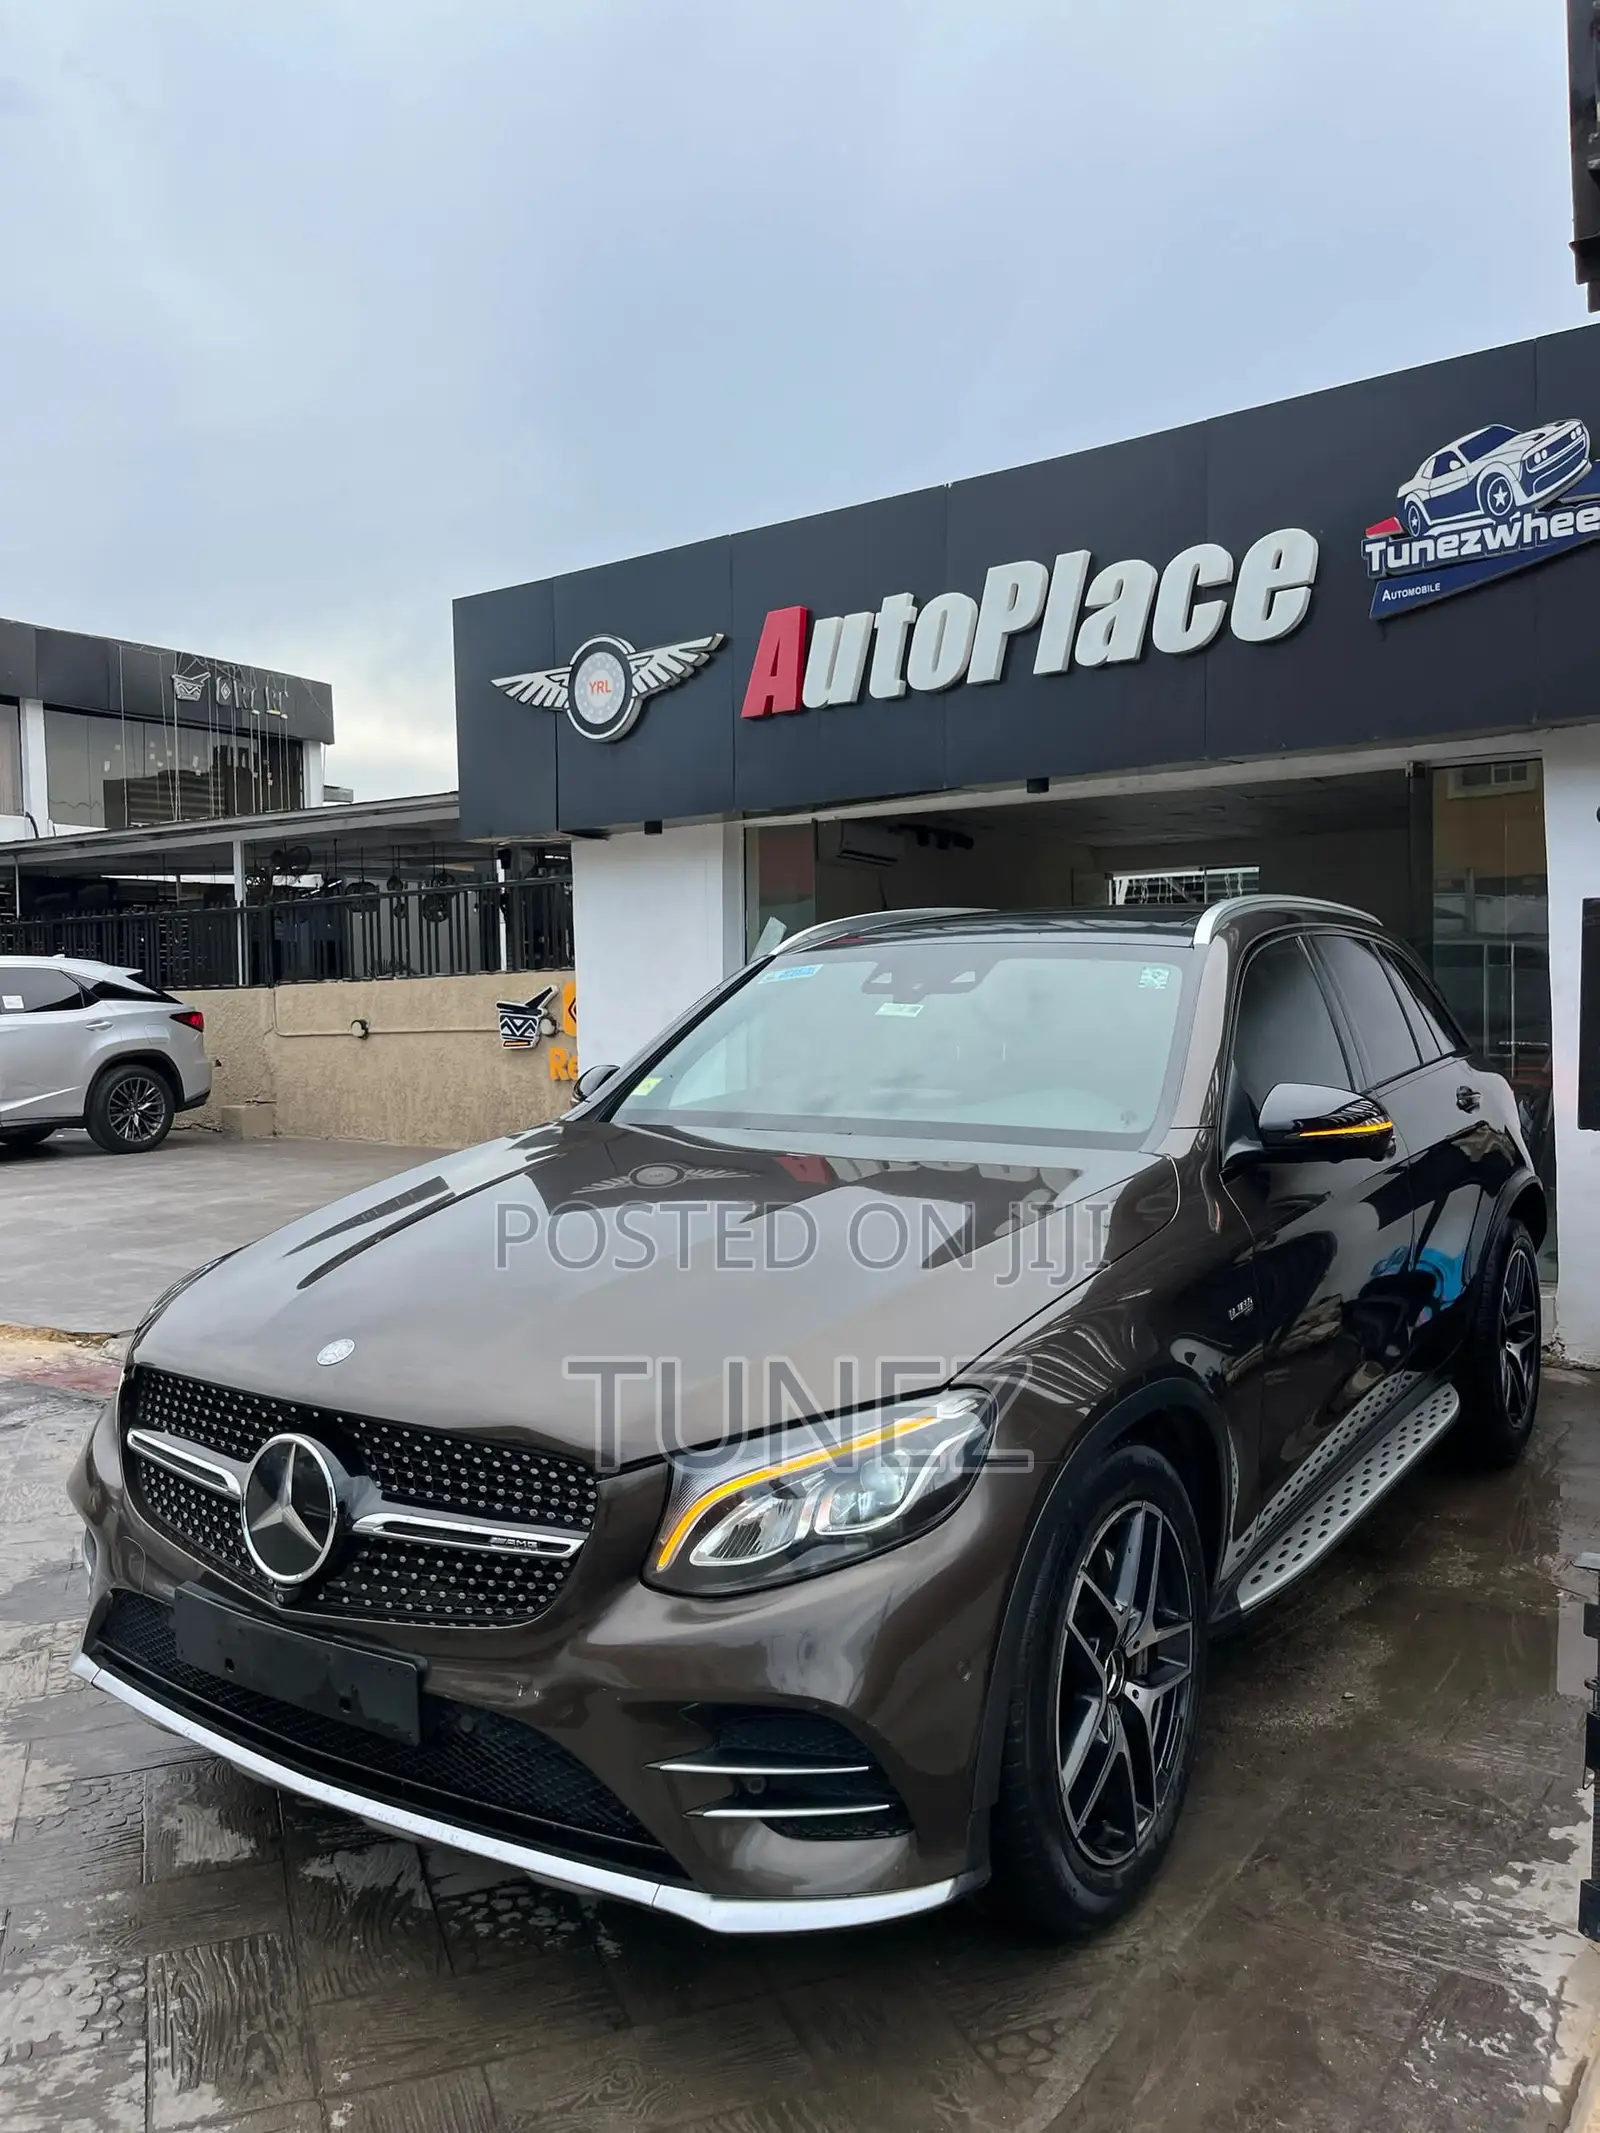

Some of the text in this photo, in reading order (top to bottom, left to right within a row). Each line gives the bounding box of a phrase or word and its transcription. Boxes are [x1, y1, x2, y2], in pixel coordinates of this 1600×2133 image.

[1382, 582, 1441, 602] AUTOMOBILE
[740, 527, 1319, 719] AutoPlace
[588, 679, 612, 695] YRL
